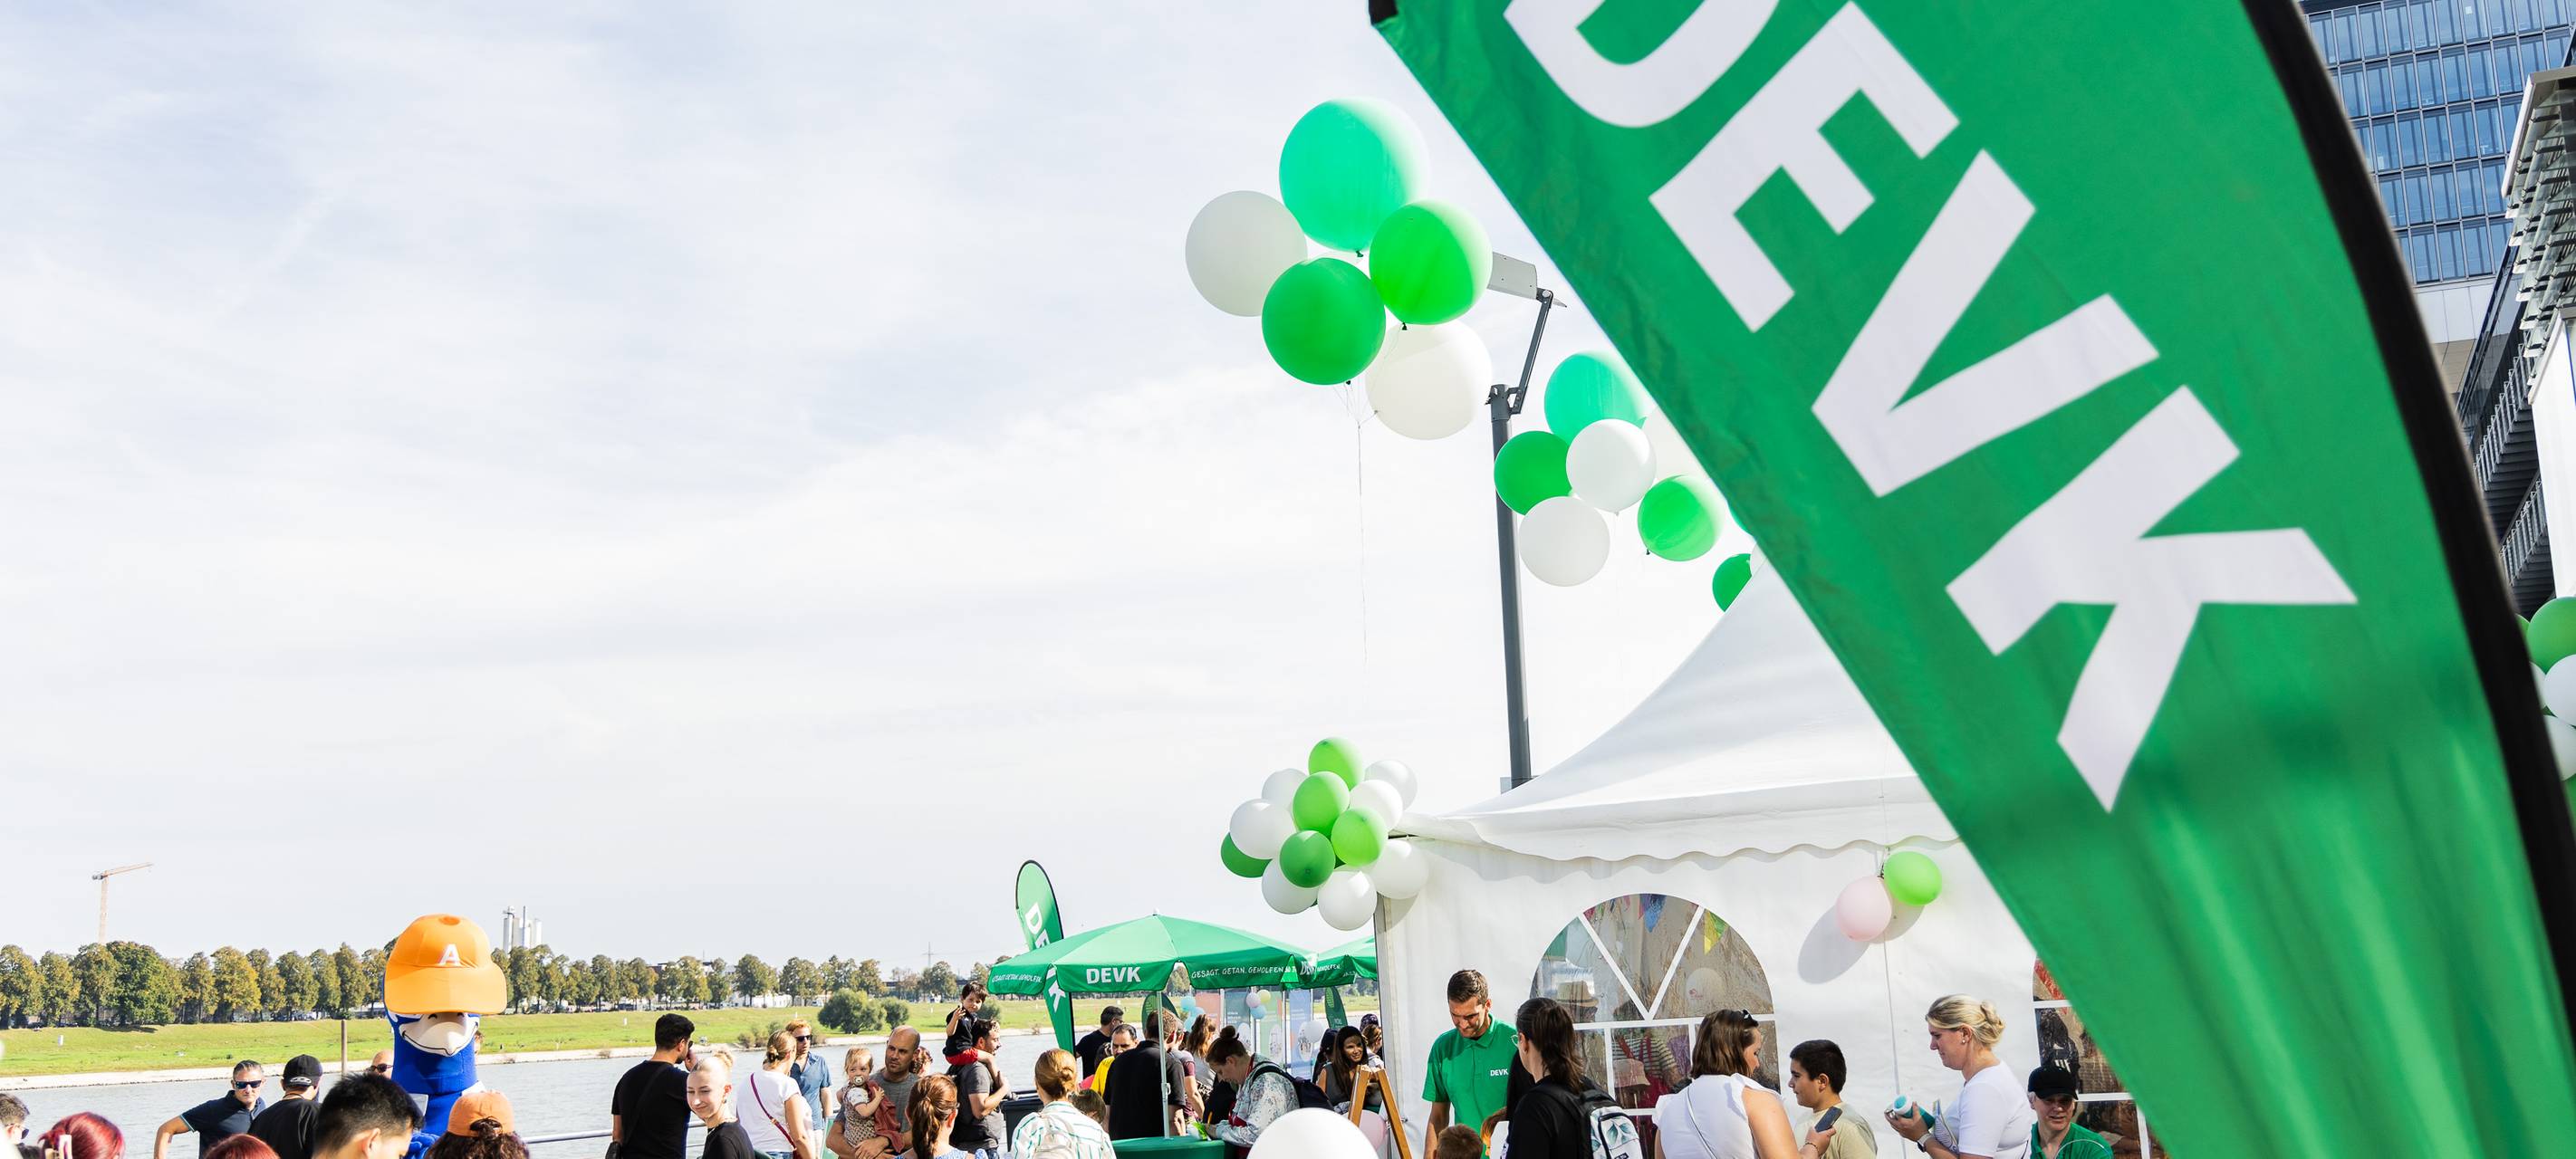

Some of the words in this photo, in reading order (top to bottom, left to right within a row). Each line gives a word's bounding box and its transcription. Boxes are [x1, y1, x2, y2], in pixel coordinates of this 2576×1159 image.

[439, 943, 462, 966] A
[1087, 966, 1140, 983] DEVK
[1191, 969, 1219, 979] GESAGT.
[1222, 966, 1246, 975] GETAN.
[1490, 1068, 1509, 1077] DEVK
